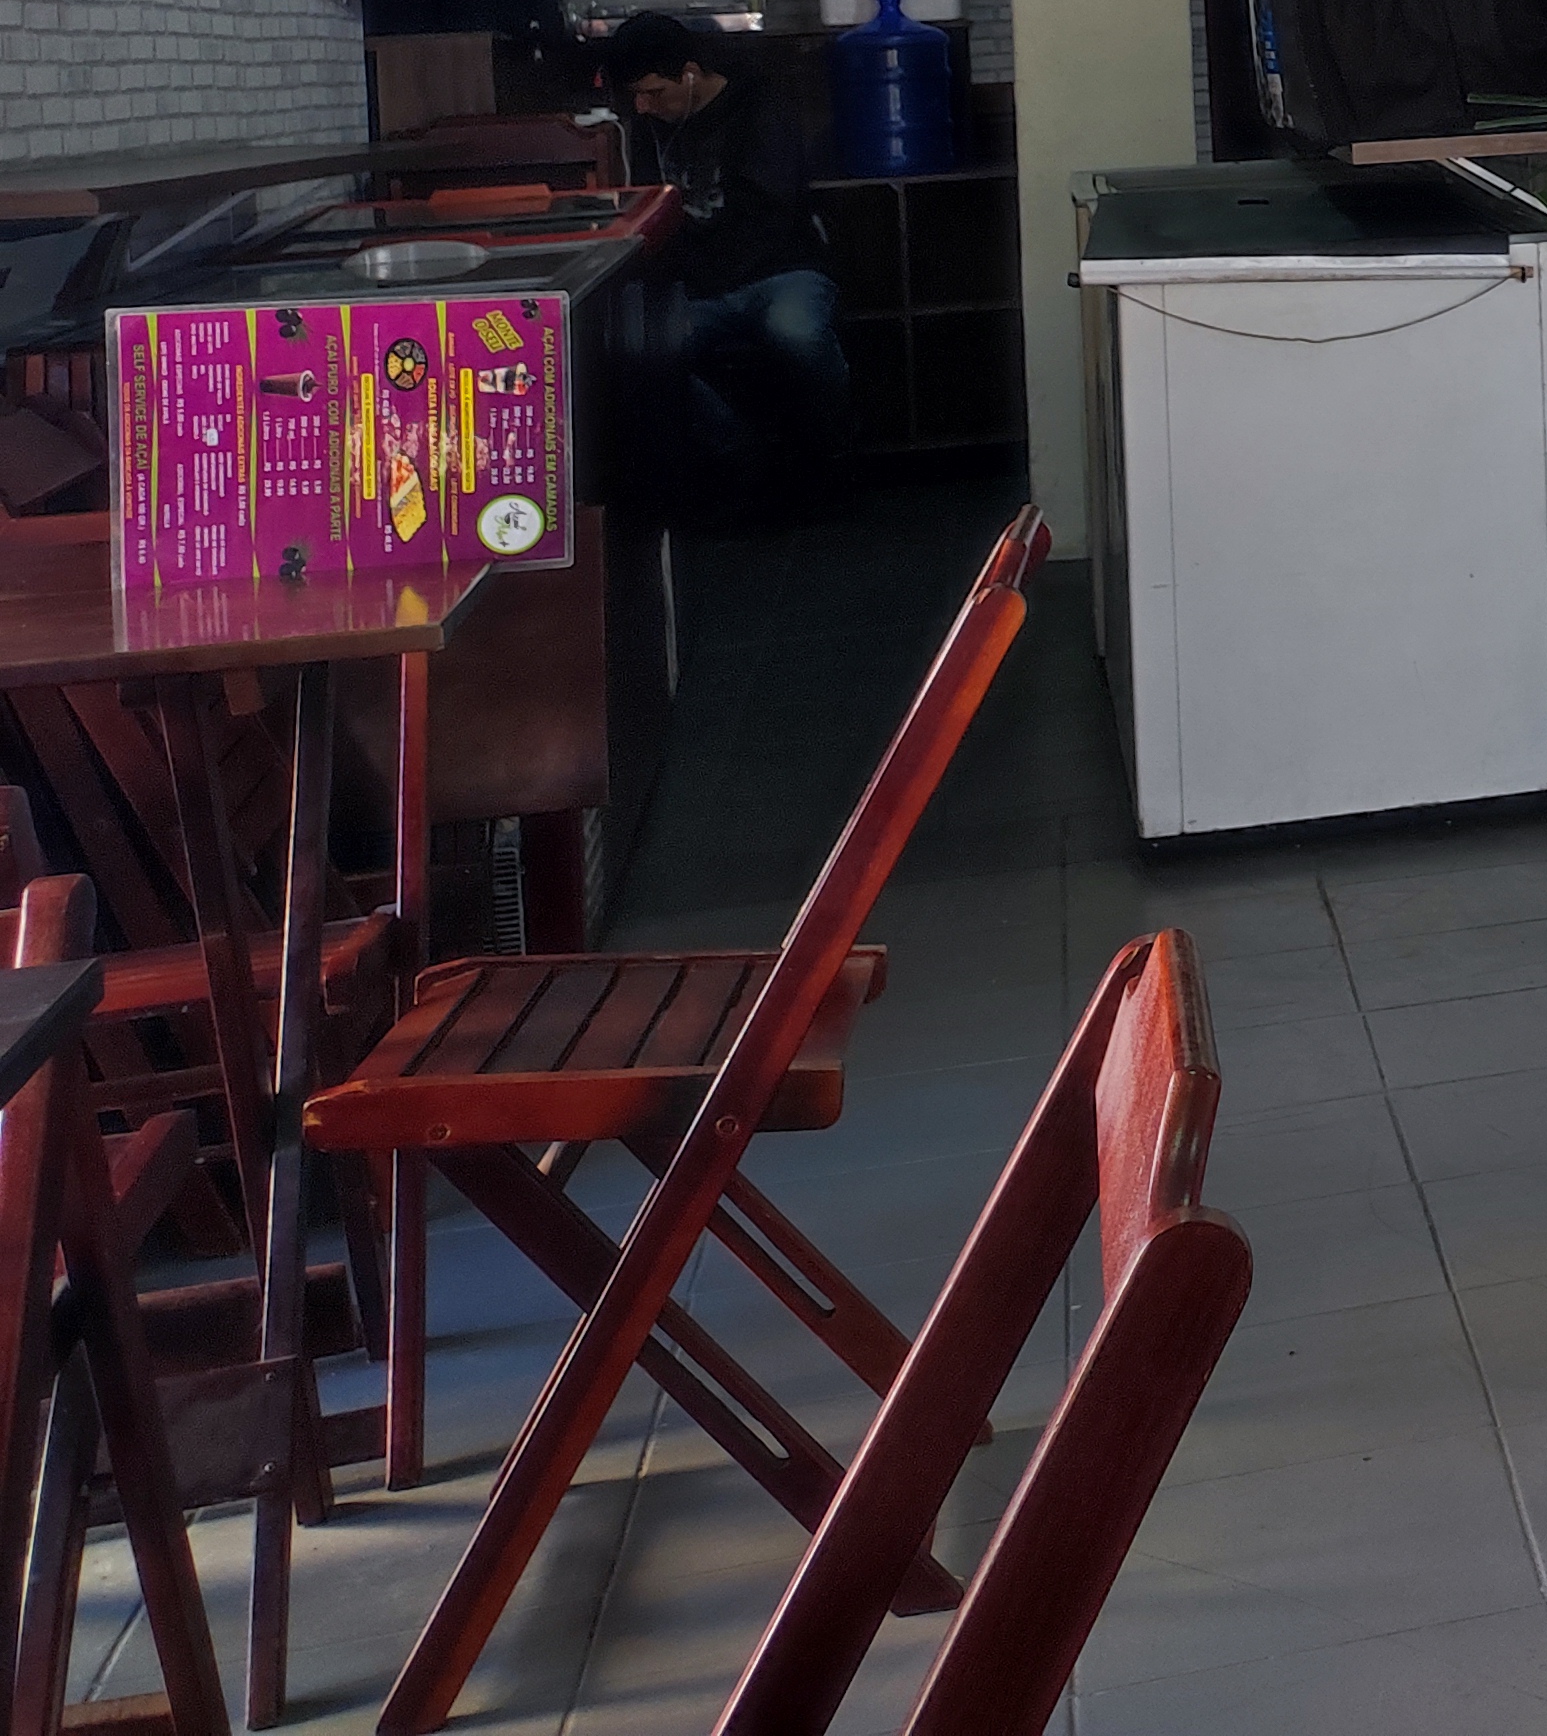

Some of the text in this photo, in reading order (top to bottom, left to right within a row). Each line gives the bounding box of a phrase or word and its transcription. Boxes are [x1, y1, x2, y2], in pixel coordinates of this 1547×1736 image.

[488, 312, 522, 348] MONTE
[133, 344, 145, 371] SELF
[544, 357, 554, 384] COM
[327, 363, 339, 395] PURO
[134, 374, 146, 422] SERVICE
[328, 400, 339, 425] COM
[136, 424, 147, 440] DE
[544, 385, 556, 451] ADICIONAIS
[328, 430, 340, 493] ADICIONAIS
[546, 453, 556, 471] EM
[544, 474, 558, 532] CAMADAS
[330, 506, 341, 541] PARTE
